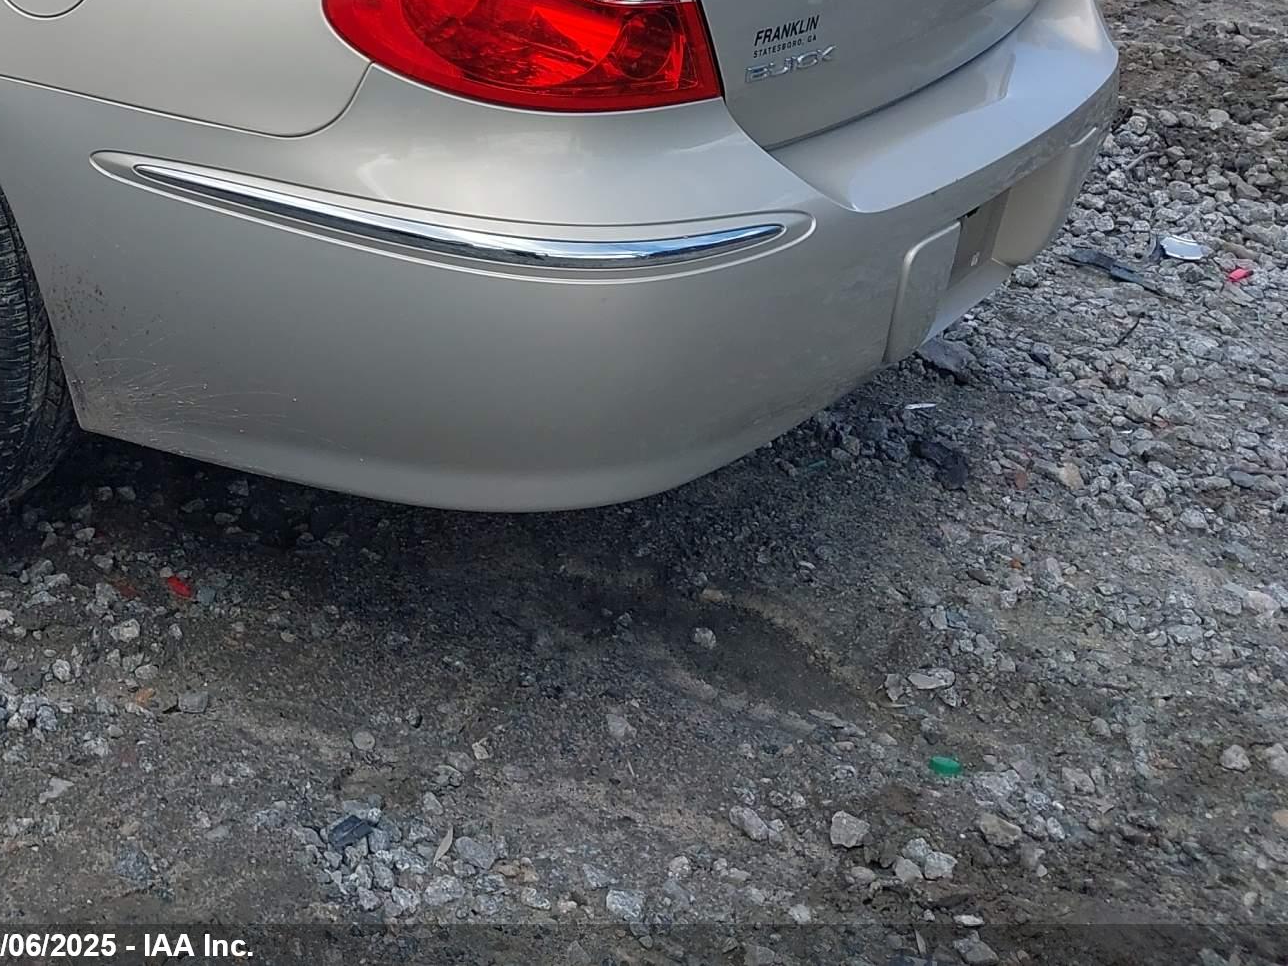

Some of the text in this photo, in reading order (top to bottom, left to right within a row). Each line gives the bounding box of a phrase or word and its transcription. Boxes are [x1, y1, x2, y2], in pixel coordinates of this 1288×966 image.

[754, 15, 820, 47] FRANKLIN
[807, 34, 817, 43] GA
[744, 44, 837, 83] BUICK
